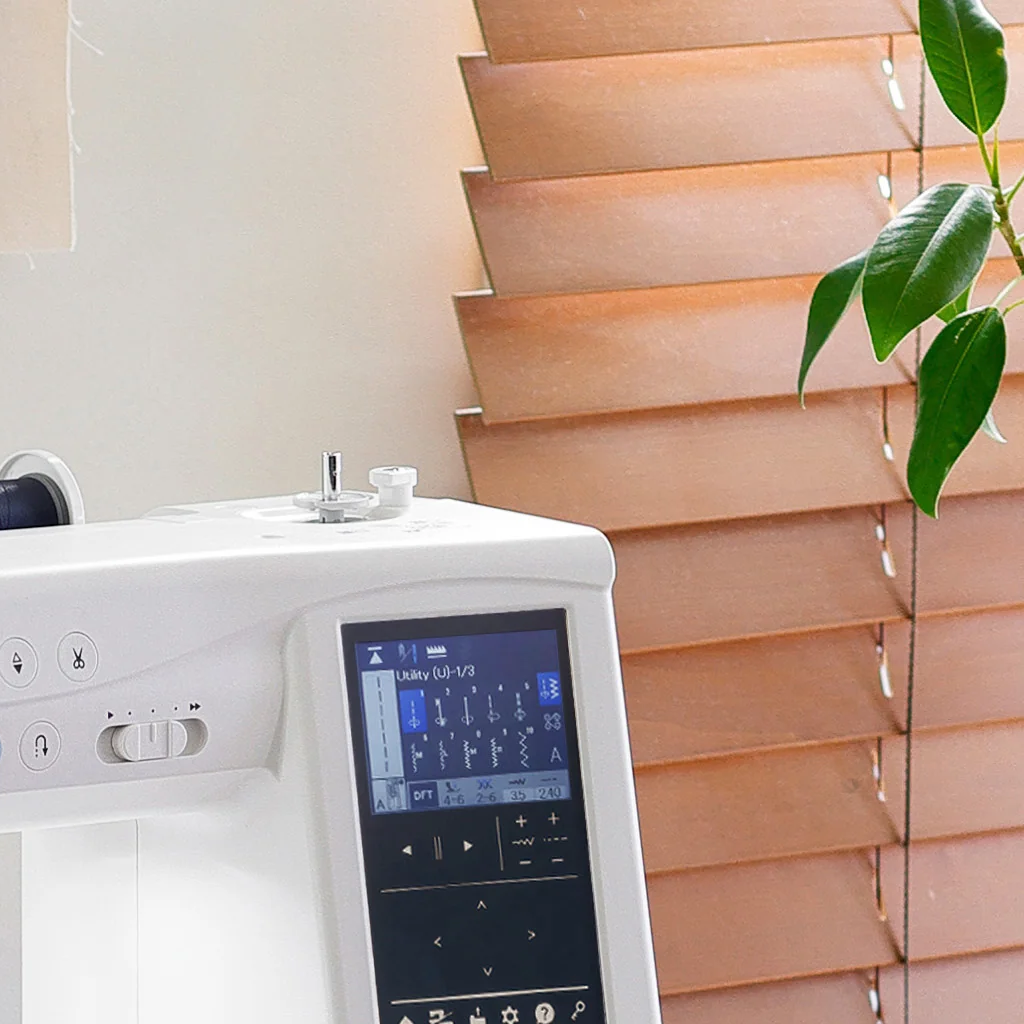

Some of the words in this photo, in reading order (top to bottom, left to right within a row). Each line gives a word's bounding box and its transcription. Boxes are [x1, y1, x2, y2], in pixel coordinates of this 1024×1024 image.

[397, 669, 429, 682] Utility
[433, 664, 475, 680] (U)-1/3
[550, 747, 562, 762] A
